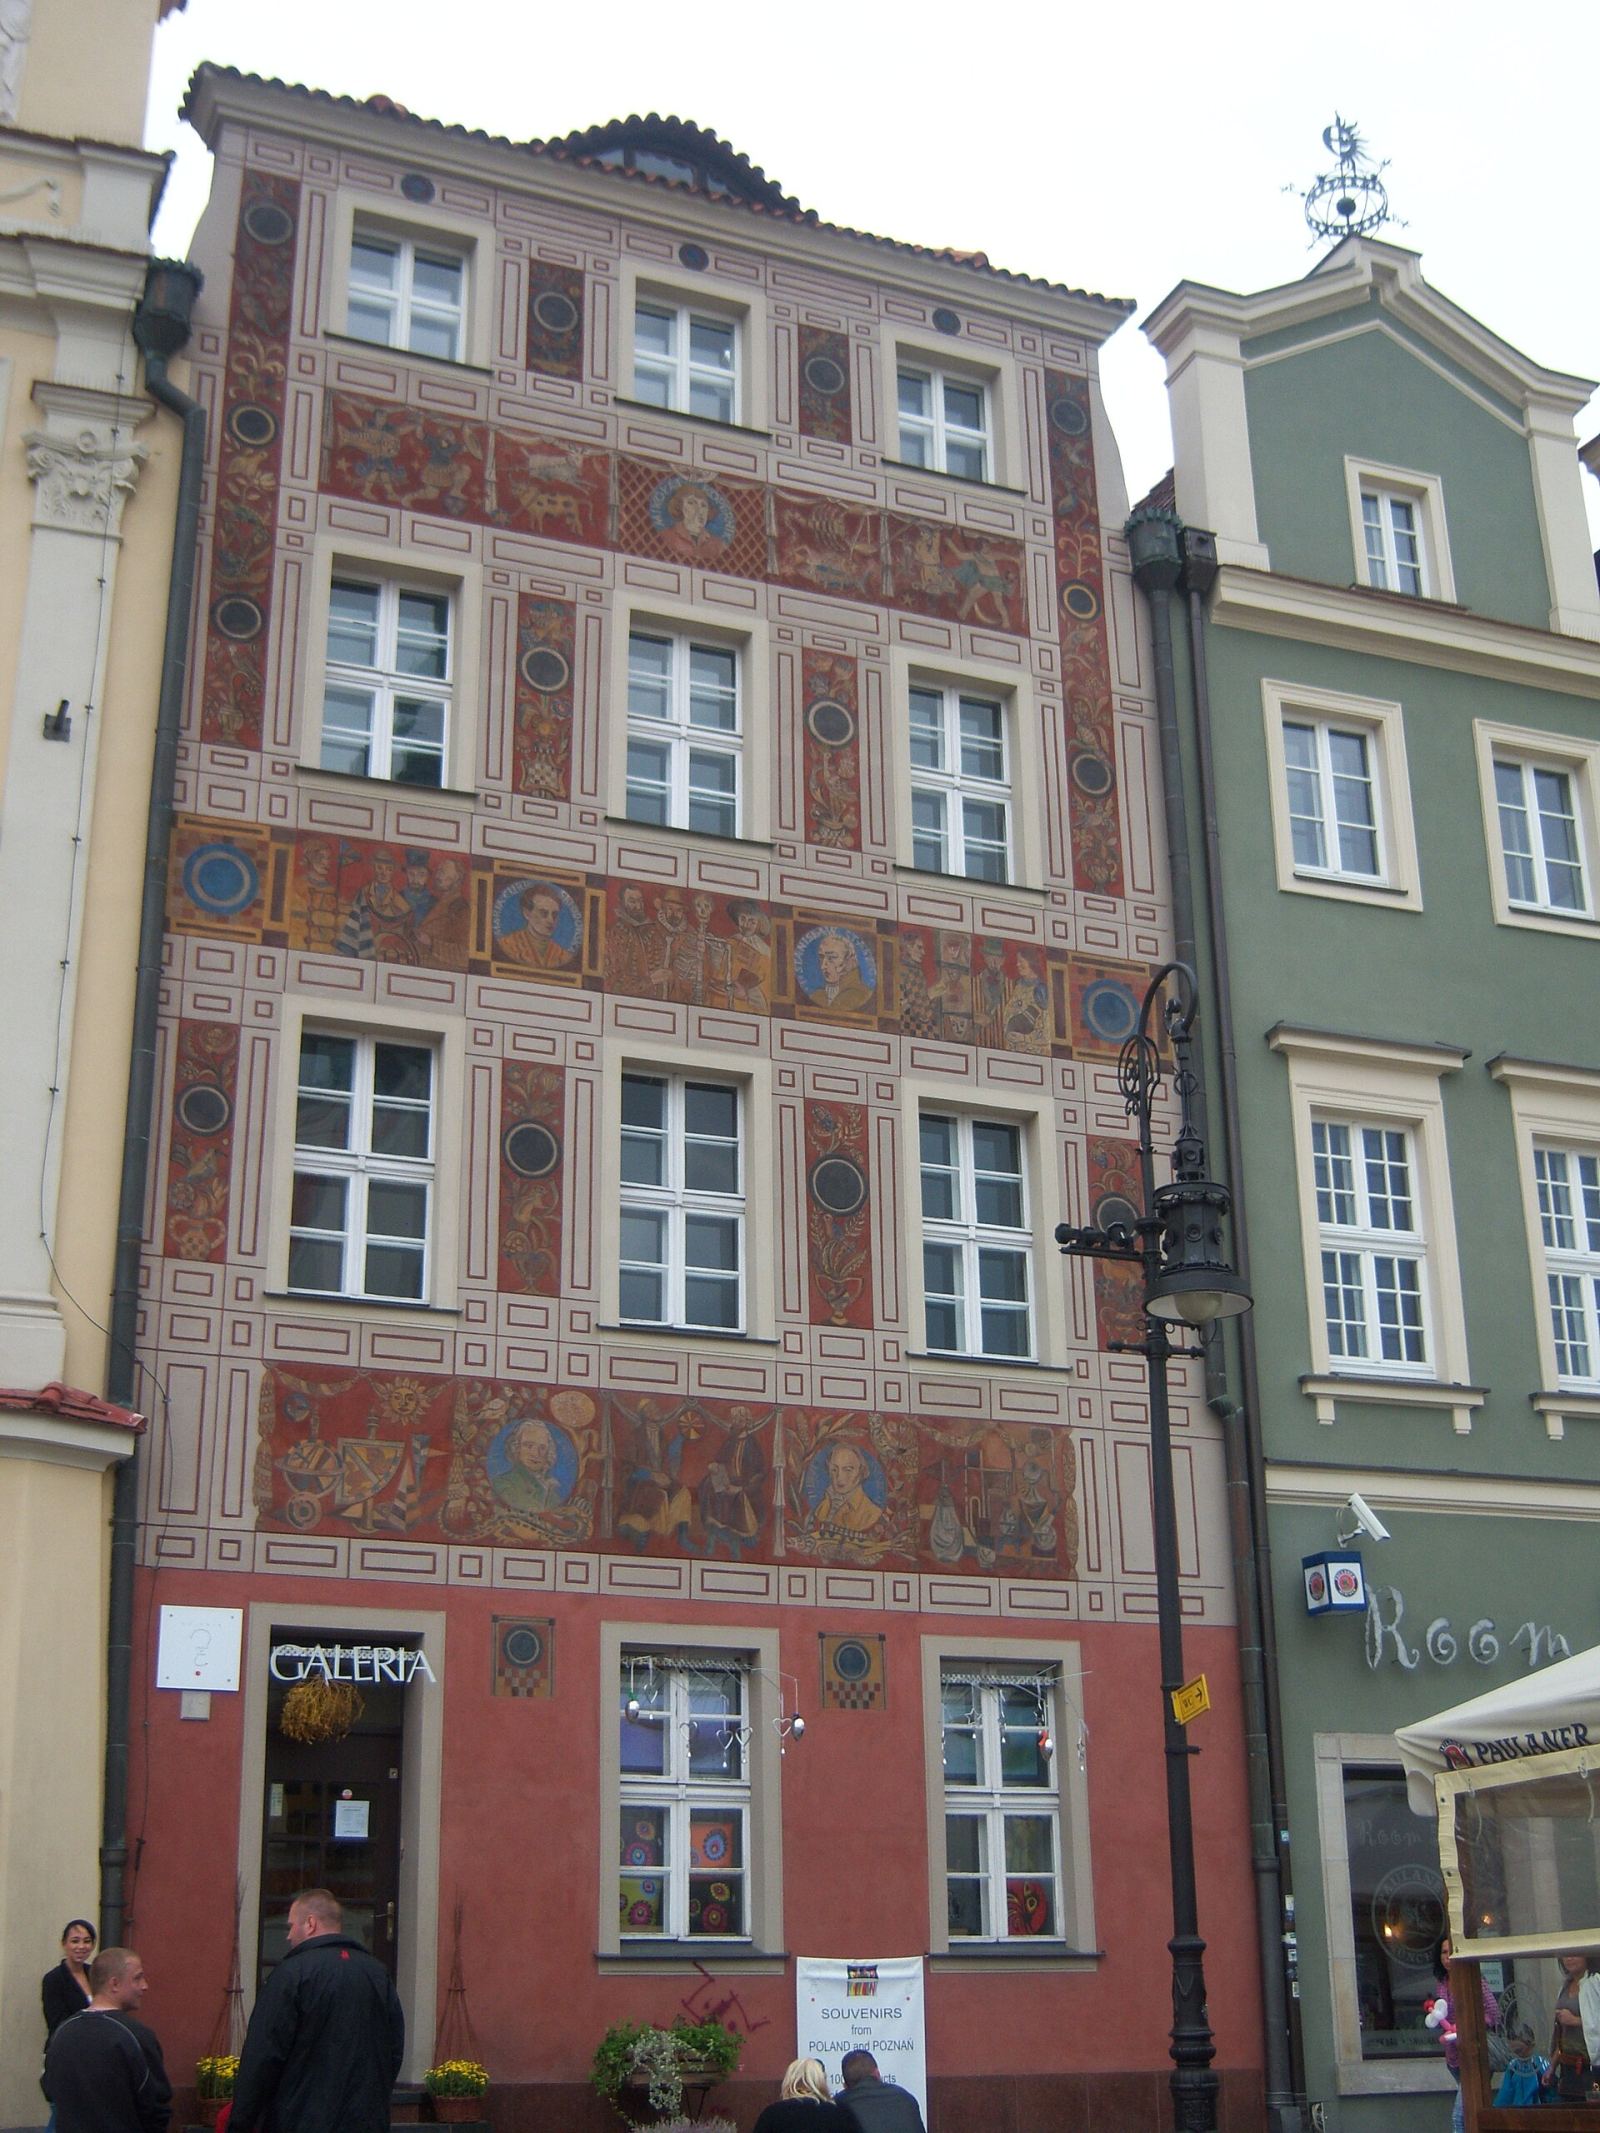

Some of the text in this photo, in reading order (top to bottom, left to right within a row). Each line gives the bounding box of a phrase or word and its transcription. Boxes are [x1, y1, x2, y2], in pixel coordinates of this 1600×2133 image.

[270, 1643, 437, 1683] GALERIA
[1472, 1722, 1591, 1765] PAULANER
[821, 2007, 902, 2020] SOUVENIRS
[851, 2024, 872, 2035] from
[809, 2037, 914, 2052] POLAND and POZNAŃ
